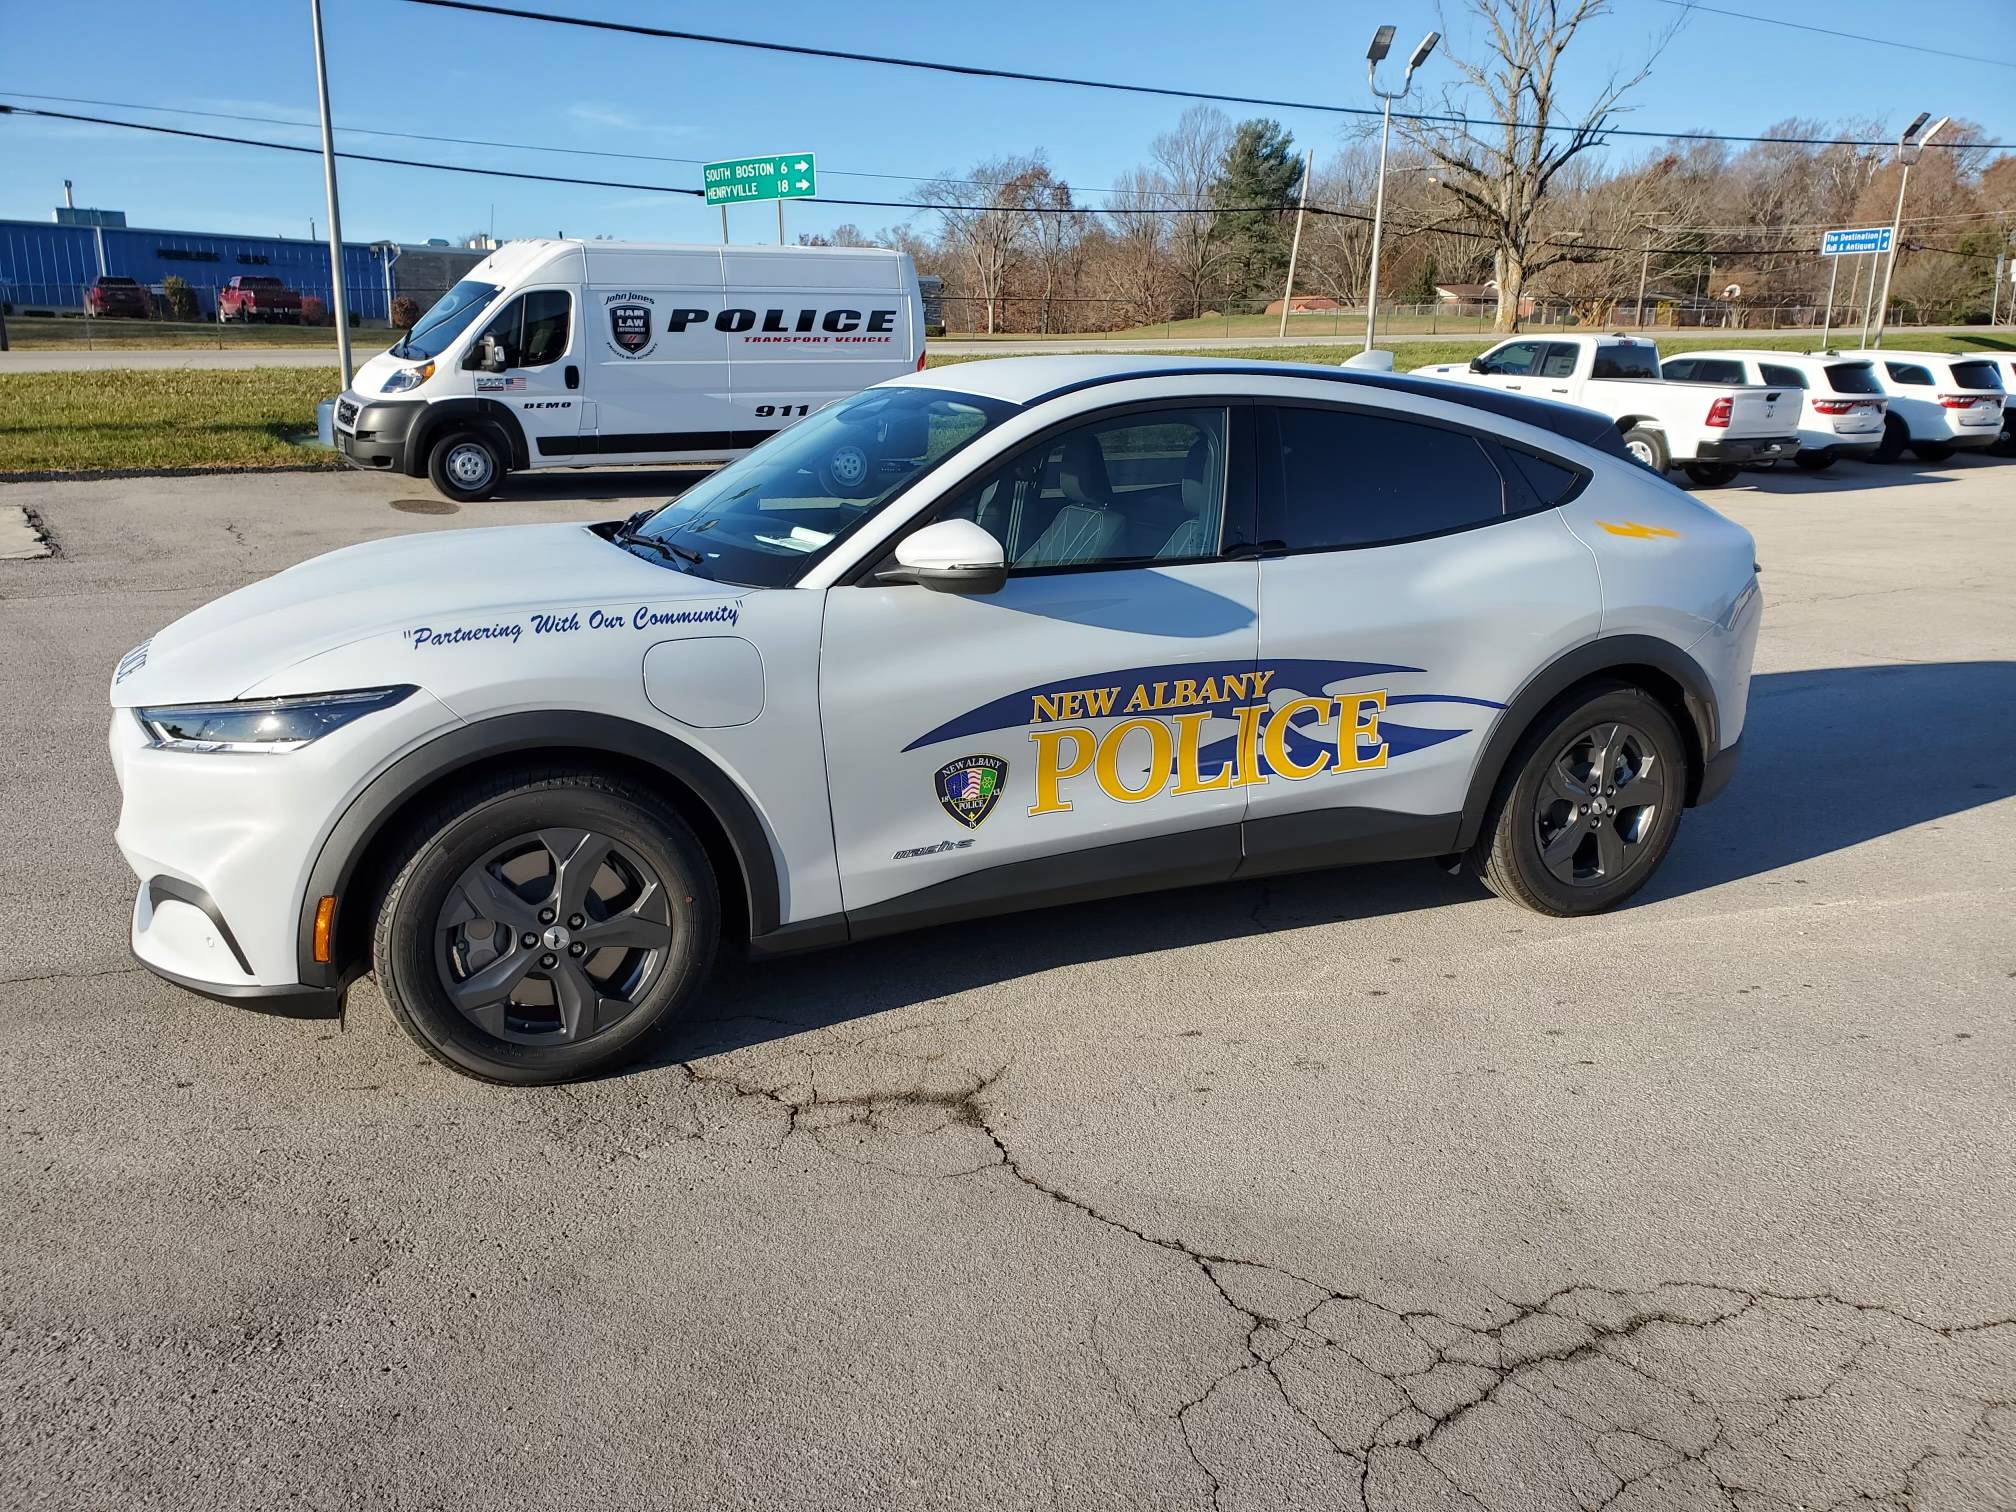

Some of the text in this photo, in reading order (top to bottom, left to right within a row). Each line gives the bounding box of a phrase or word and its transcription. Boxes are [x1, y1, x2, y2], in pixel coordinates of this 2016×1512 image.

[706, 162, 788, 182] SOUTH BOSTON 6
[707, 180, 789, 200] HENRYVILLE 18
[1827, 232, 1879, 242] The Destination
[1845, 243, 1876, 251] Antiques
[604, 292, 655, 305] John Jones
[616, 309, 645, 317] RAM
[618, 318, 644, 327] LAW
[667, 308, 897, 333] POLICE
[523, 401, 572, 409] DEMO
[754, 404, 809, 418] 911
[403, 600, 744, 650] "Partnering With Our Community"
[1030, 670, 1275, 724] NEW ALBANY
[1026, 688, 1389, 818] POLICE
[941, 757, 1002, 778] NEW ALBANY
[959, 799, 984, 811] POLICE
